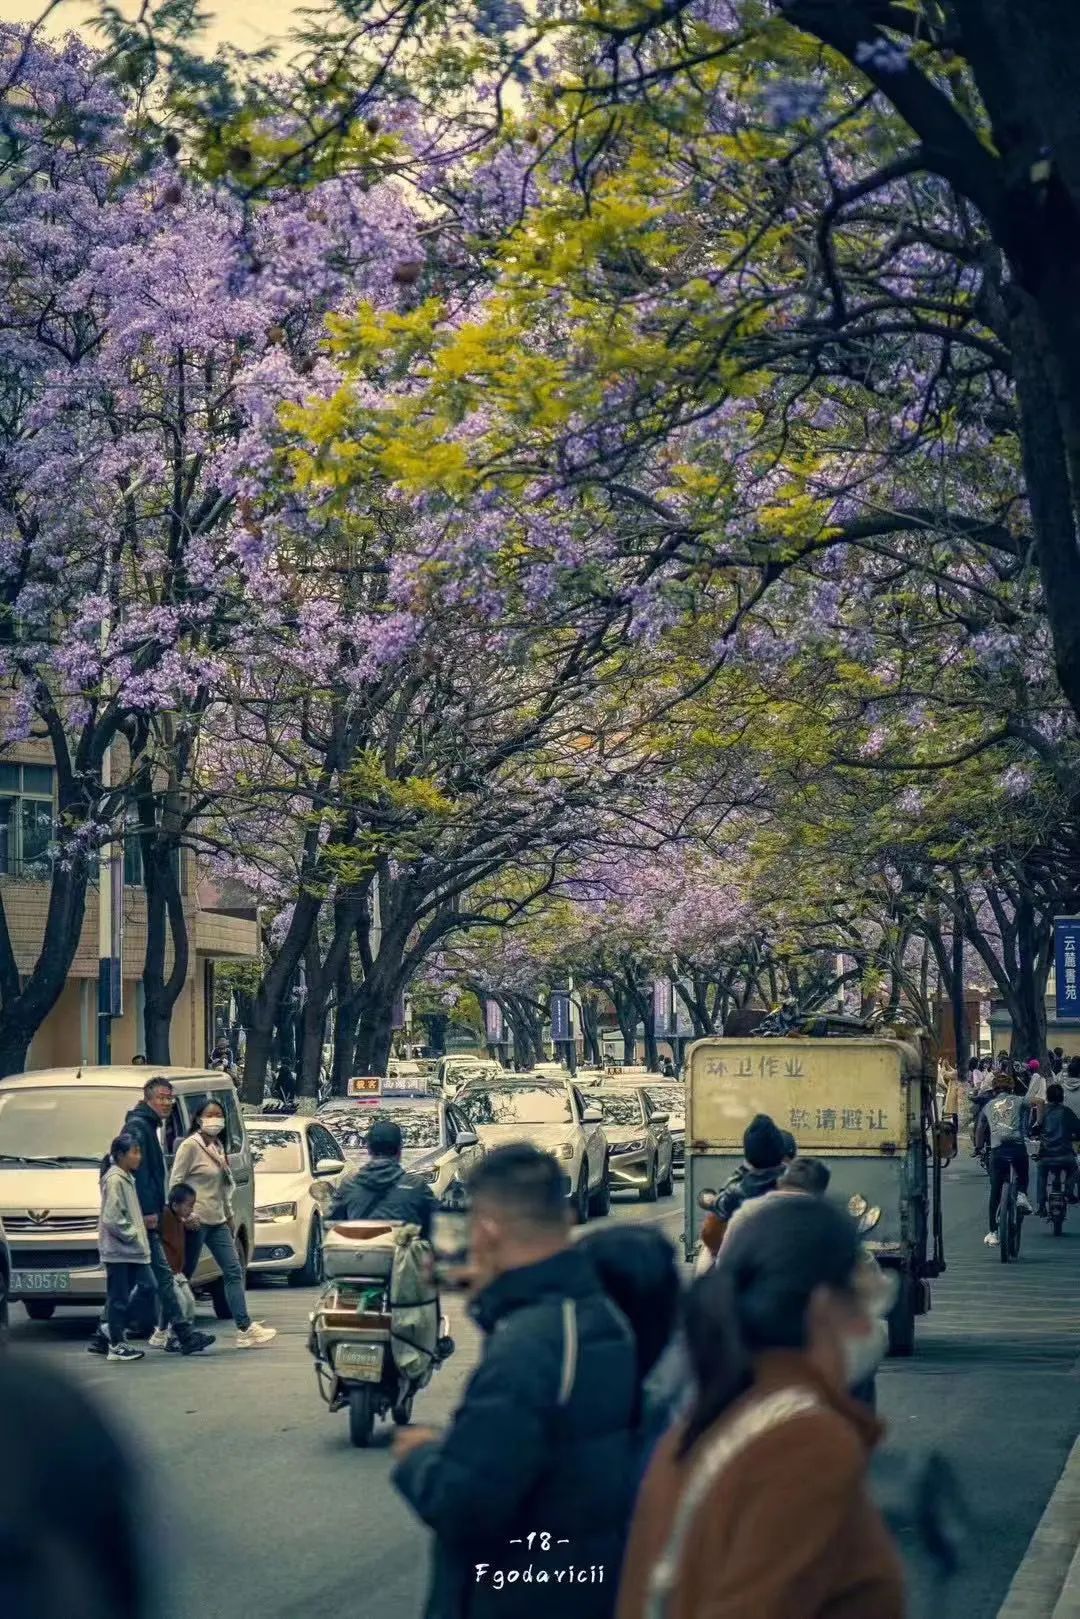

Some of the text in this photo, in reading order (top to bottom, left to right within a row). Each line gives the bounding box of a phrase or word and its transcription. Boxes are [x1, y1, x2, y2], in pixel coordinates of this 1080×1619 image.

[704, 1056, 804, 1077] 环卫作业
[789, 1108, 889, 1131] 敬请避让
